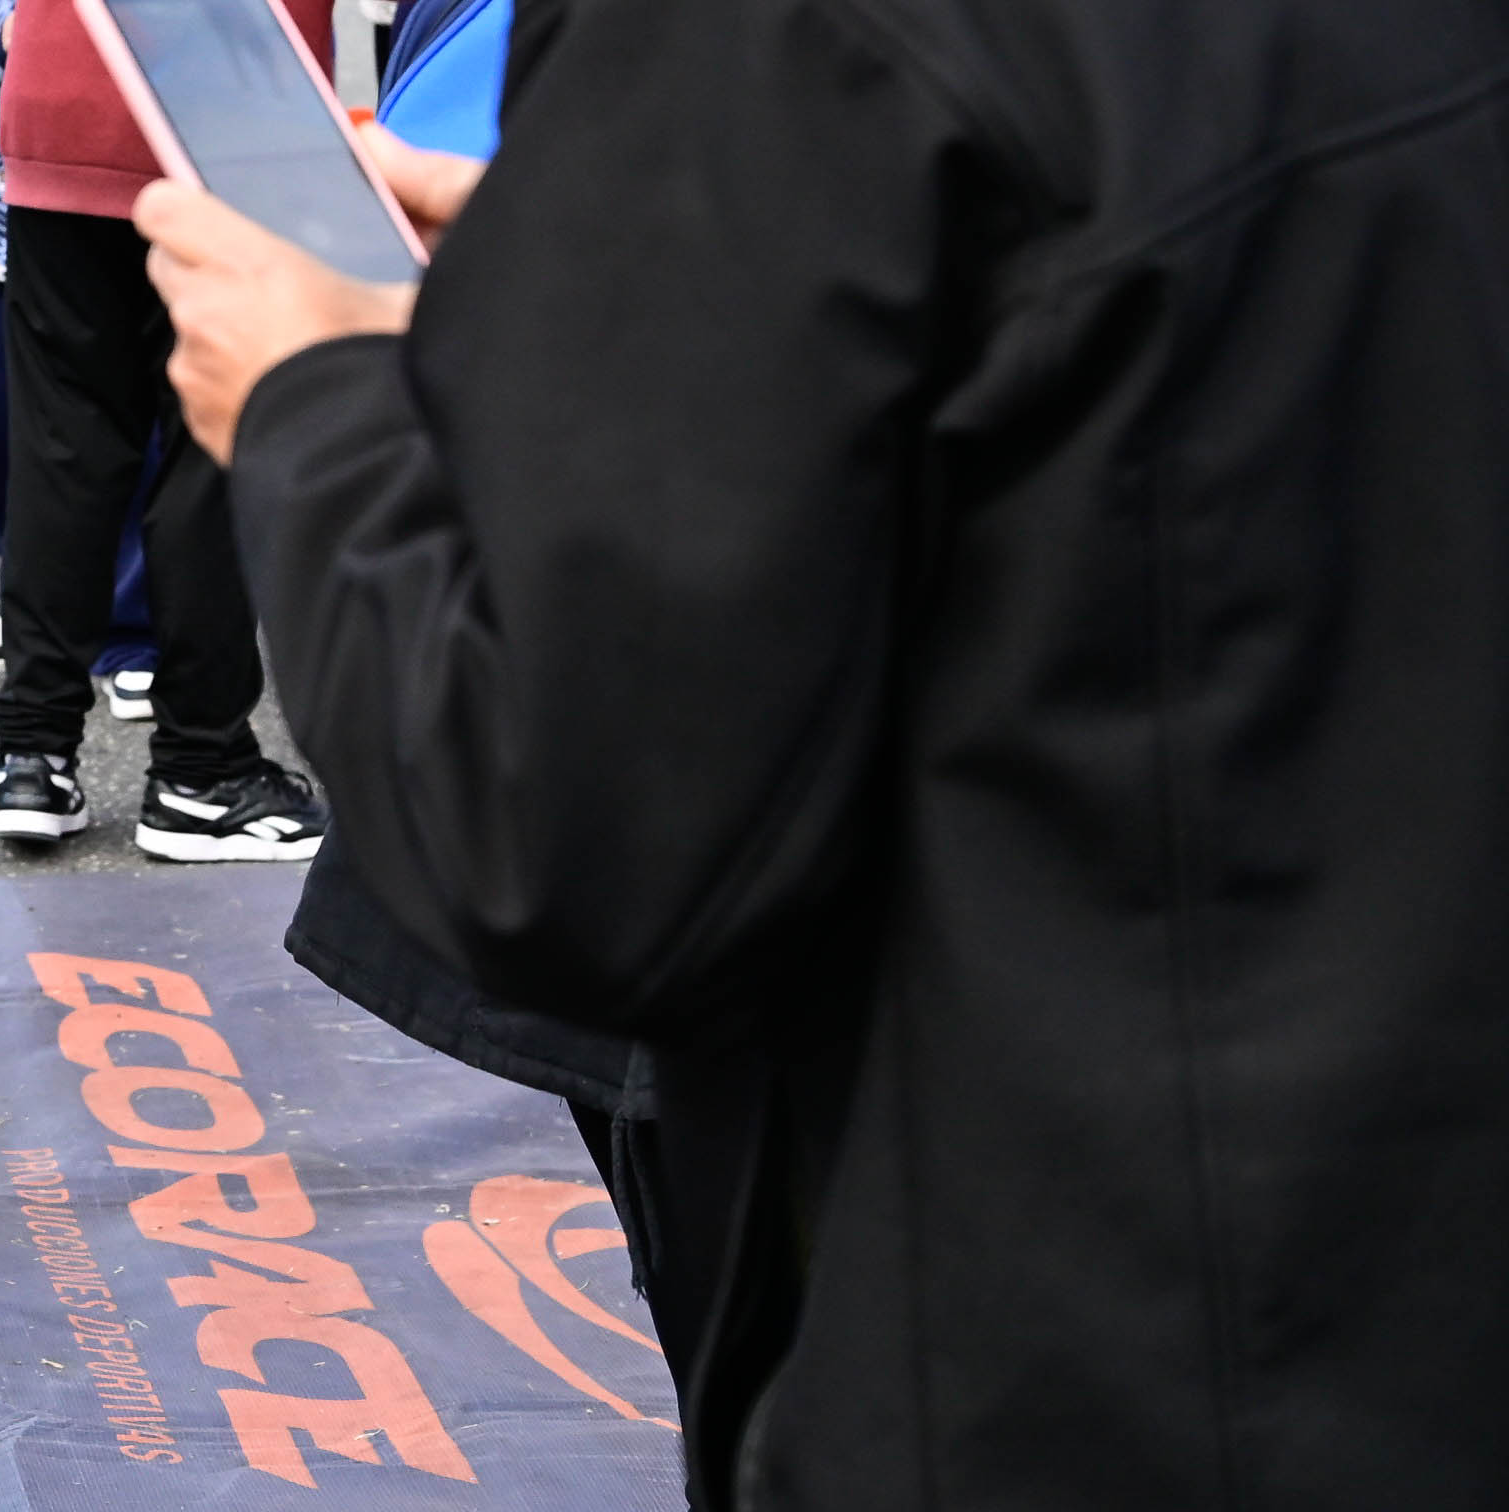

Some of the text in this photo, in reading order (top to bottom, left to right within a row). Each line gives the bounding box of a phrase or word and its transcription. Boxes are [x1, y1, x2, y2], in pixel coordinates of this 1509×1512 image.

[0, 1146, 184, 1465] PRODUCCIONES DEPORTIVAS
[26, 951, 479, 1489] ECORACE
